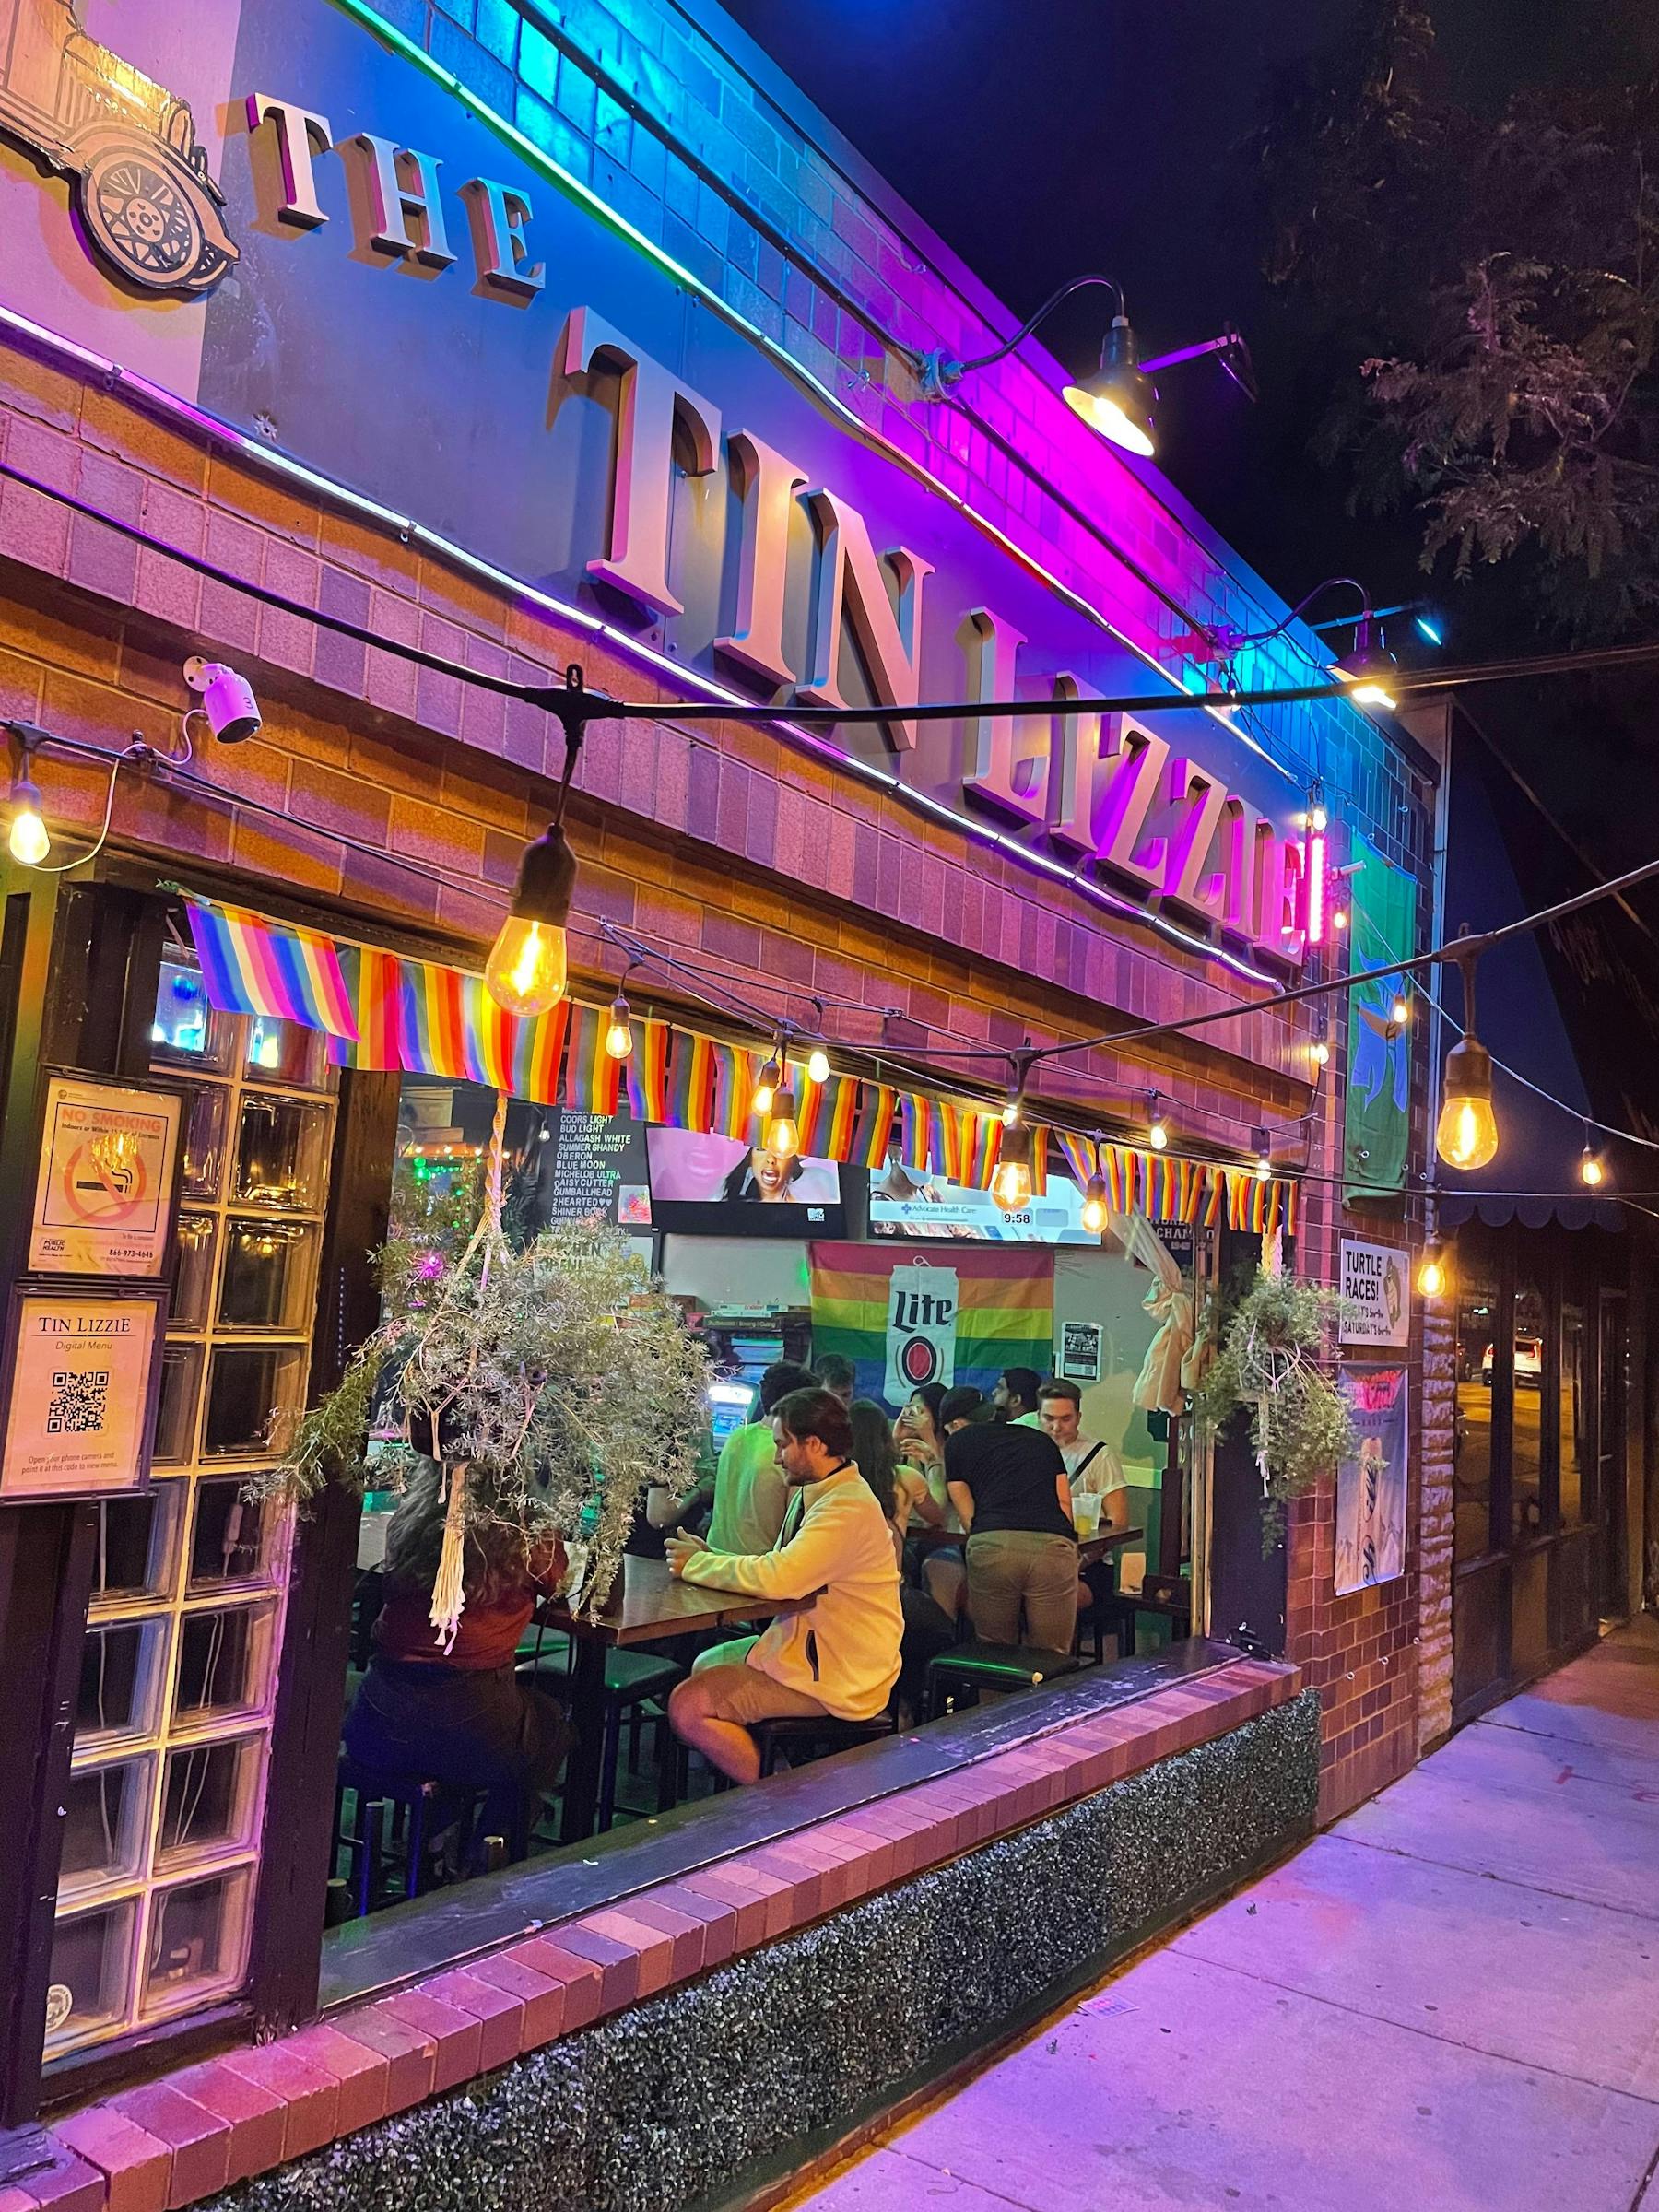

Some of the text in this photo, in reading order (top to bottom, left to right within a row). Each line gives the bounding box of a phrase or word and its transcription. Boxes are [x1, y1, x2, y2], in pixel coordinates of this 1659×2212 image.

[246, 92, 1305, 967] THE TIN LIZZIE
[62, 1108, 163, 1133] NO SMOKING
[560, 1114, 614, 1124] COORS LIGHT
[560, 1124, 605, 1133] BUD LIGHT
[559, 1134, 631, 1144] ALLAGASH WHITE
[558, 1143, 626, 1152] SUMMER SHANDY
[557, 1151, 593, 1160] OBERON
[556, 1160, 606, 1170] BLUE MOON
[554, 1170, 621, 1180] MICHELOB ULTRA
[581, 1179, 614, 1188] CUTTER
[553, 1187, 613, 1196] GUMBALLHEAD
[551, 1206, 585, 1217] SHINER
[1004, 1213, 1030, 1225] 9:58
[1346, 1250, 1382, 1277] TURTLE
[1345, 1277, 1379, 1301] RACES!
[892, 1290, 953, 1334] Lite
[39, 1317, 131, 1333] TIN LIZZIE
[55, 1340, 112, 1352] Digital Menu
